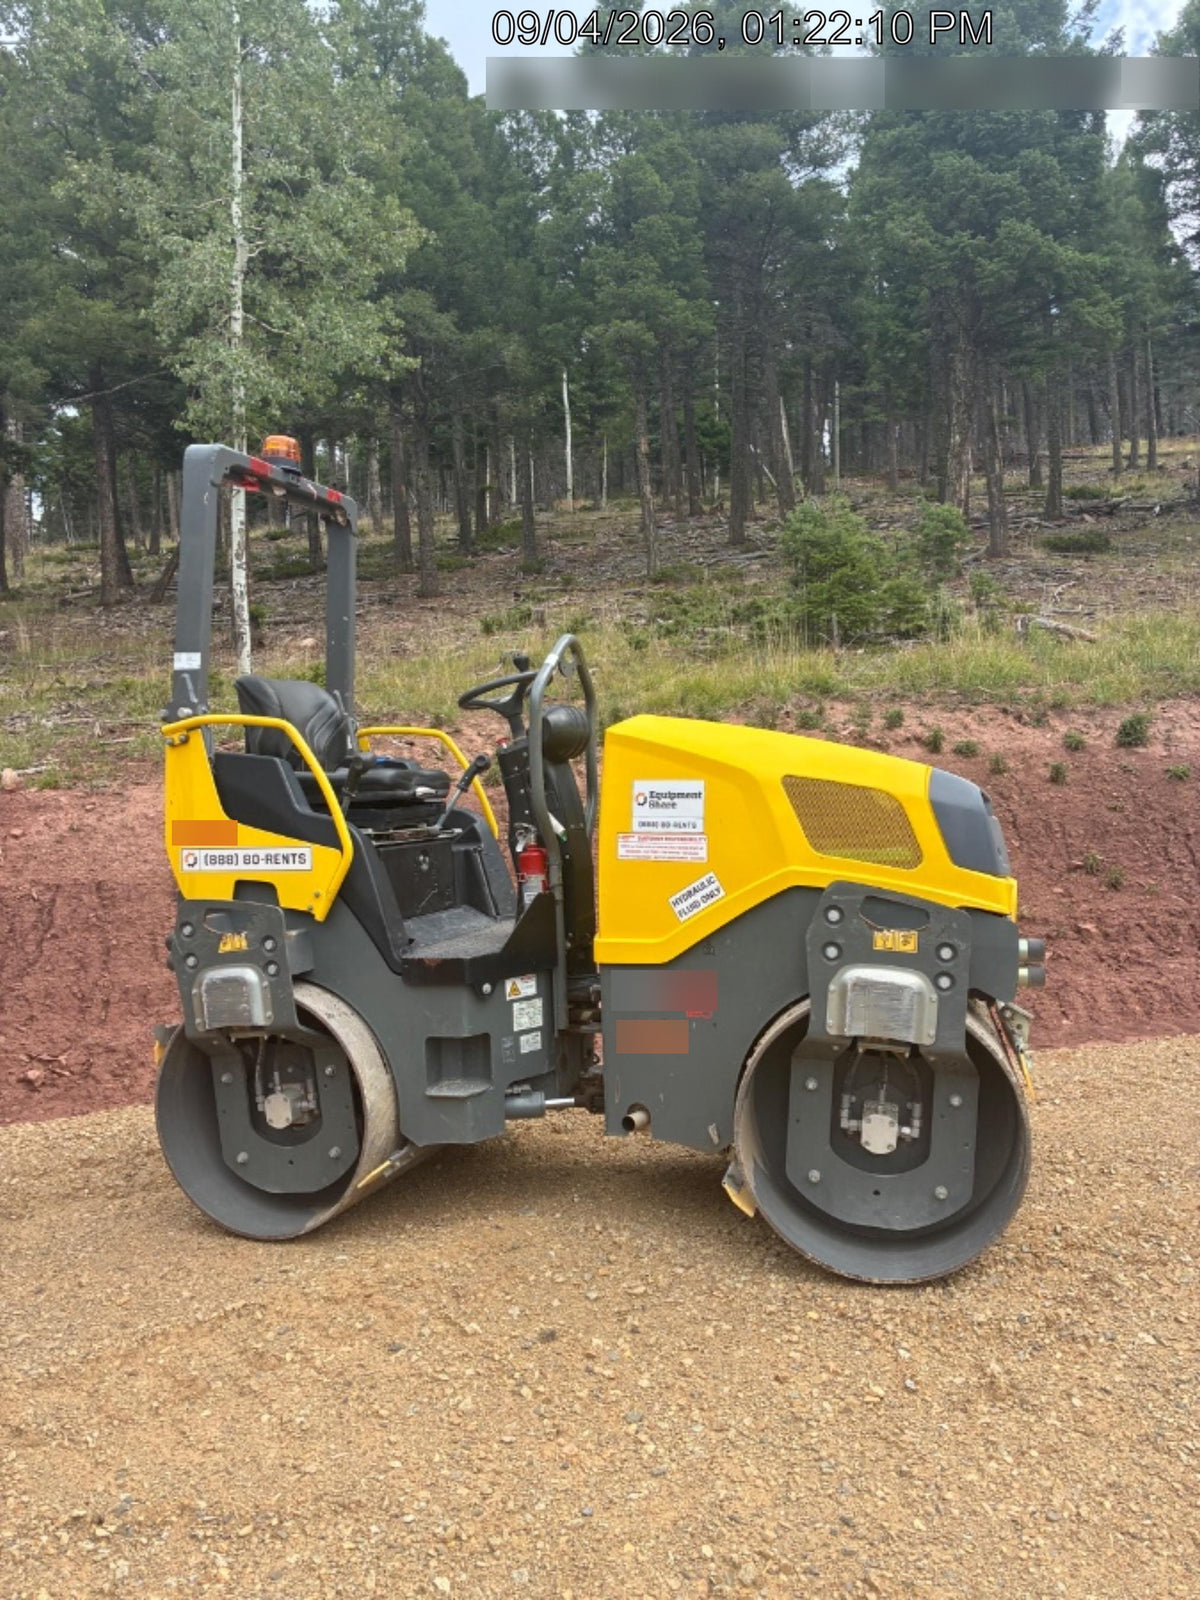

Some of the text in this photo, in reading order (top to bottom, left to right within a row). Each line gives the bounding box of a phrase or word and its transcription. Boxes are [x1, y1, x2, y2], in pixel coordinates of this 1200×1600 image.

[648, 790, 702, 801] Equipment
[648, 800, 678, 809] Share
[203, 852, 307, 866] (888) 80-RENTS
[671, 875, 717, 908] HYDRAULIC
[678, 888, 721, 918] FLUID ONLY
